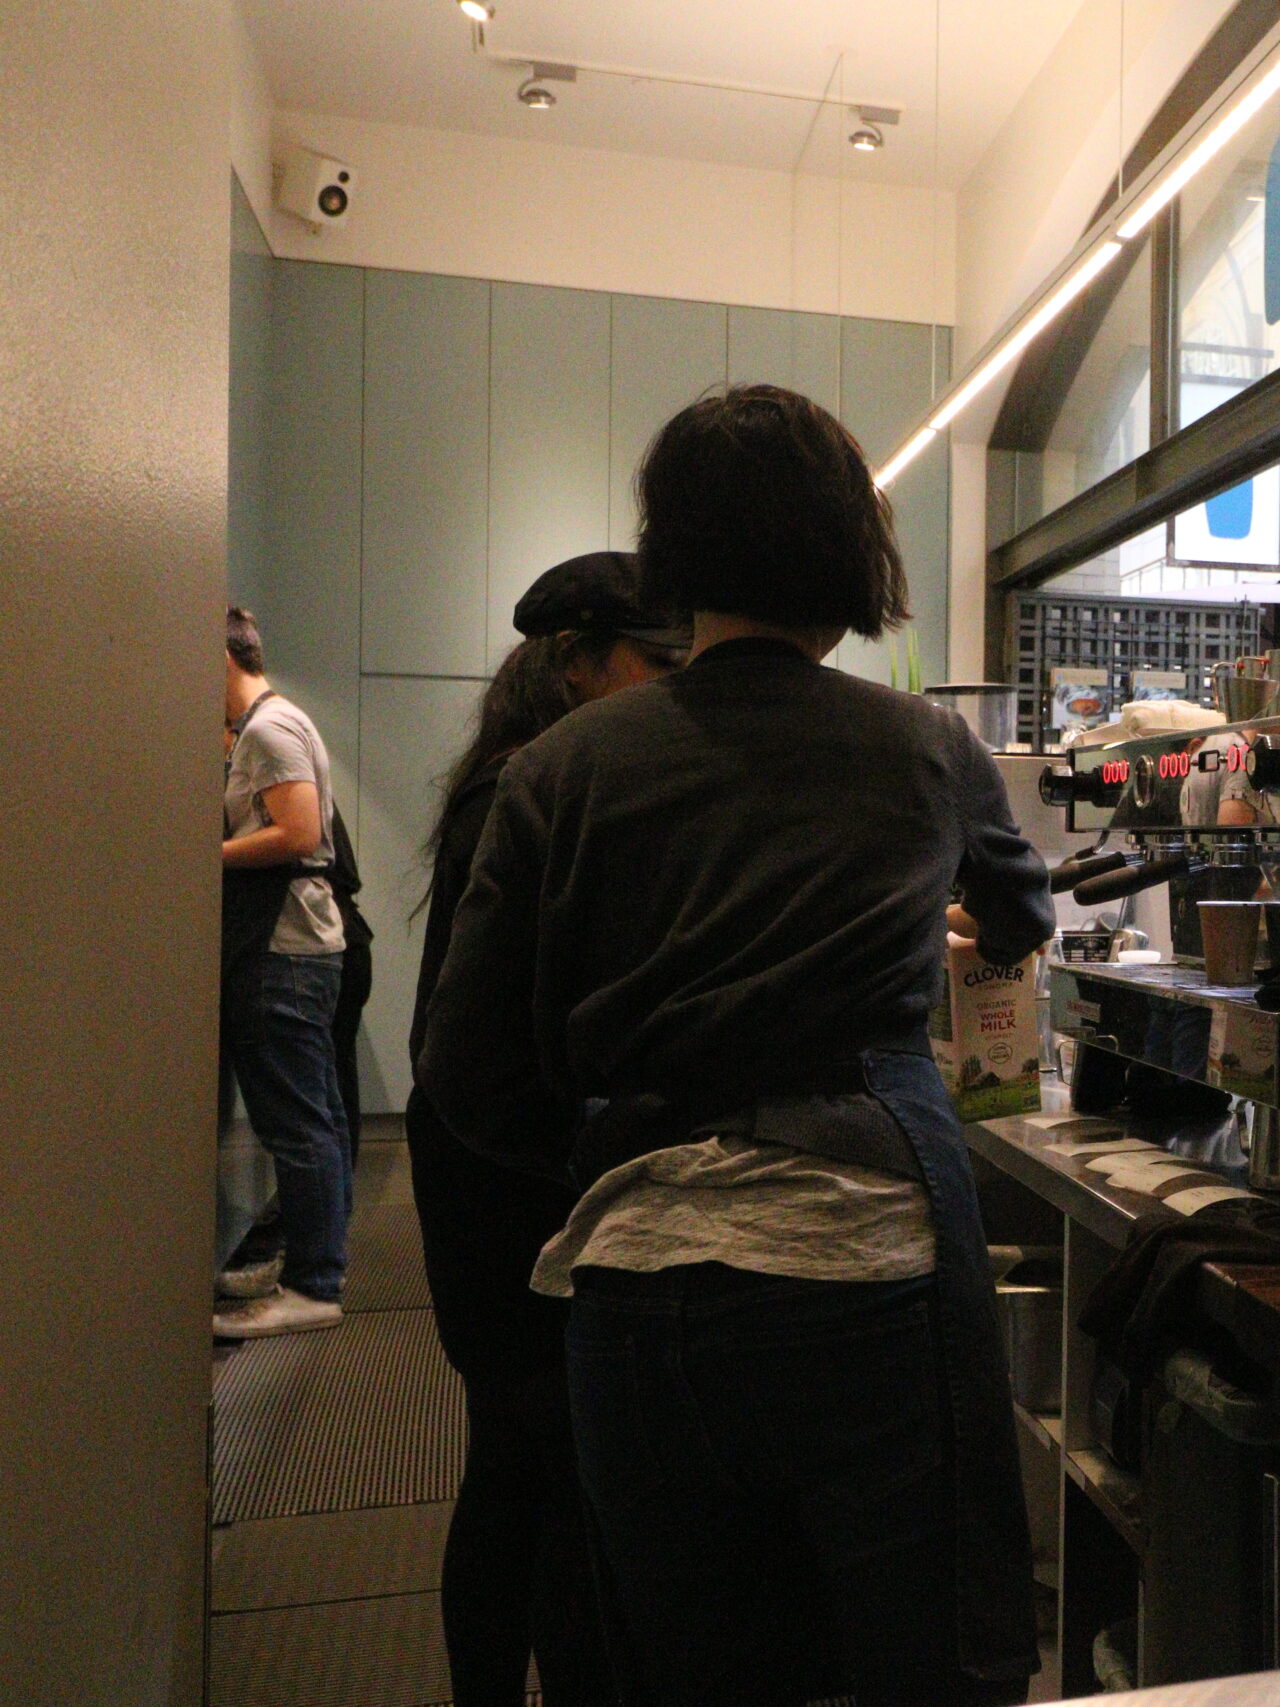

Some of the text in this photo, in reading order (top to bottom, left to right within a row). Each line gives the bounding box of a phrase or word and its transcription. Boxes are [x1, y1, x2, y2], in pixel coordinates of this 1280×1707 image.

[964, 967, 1024, 987] CLOVER
[980, 1009, 1015, 1021] WHOLE
[980, 1018, 1017, 1032] MILK
